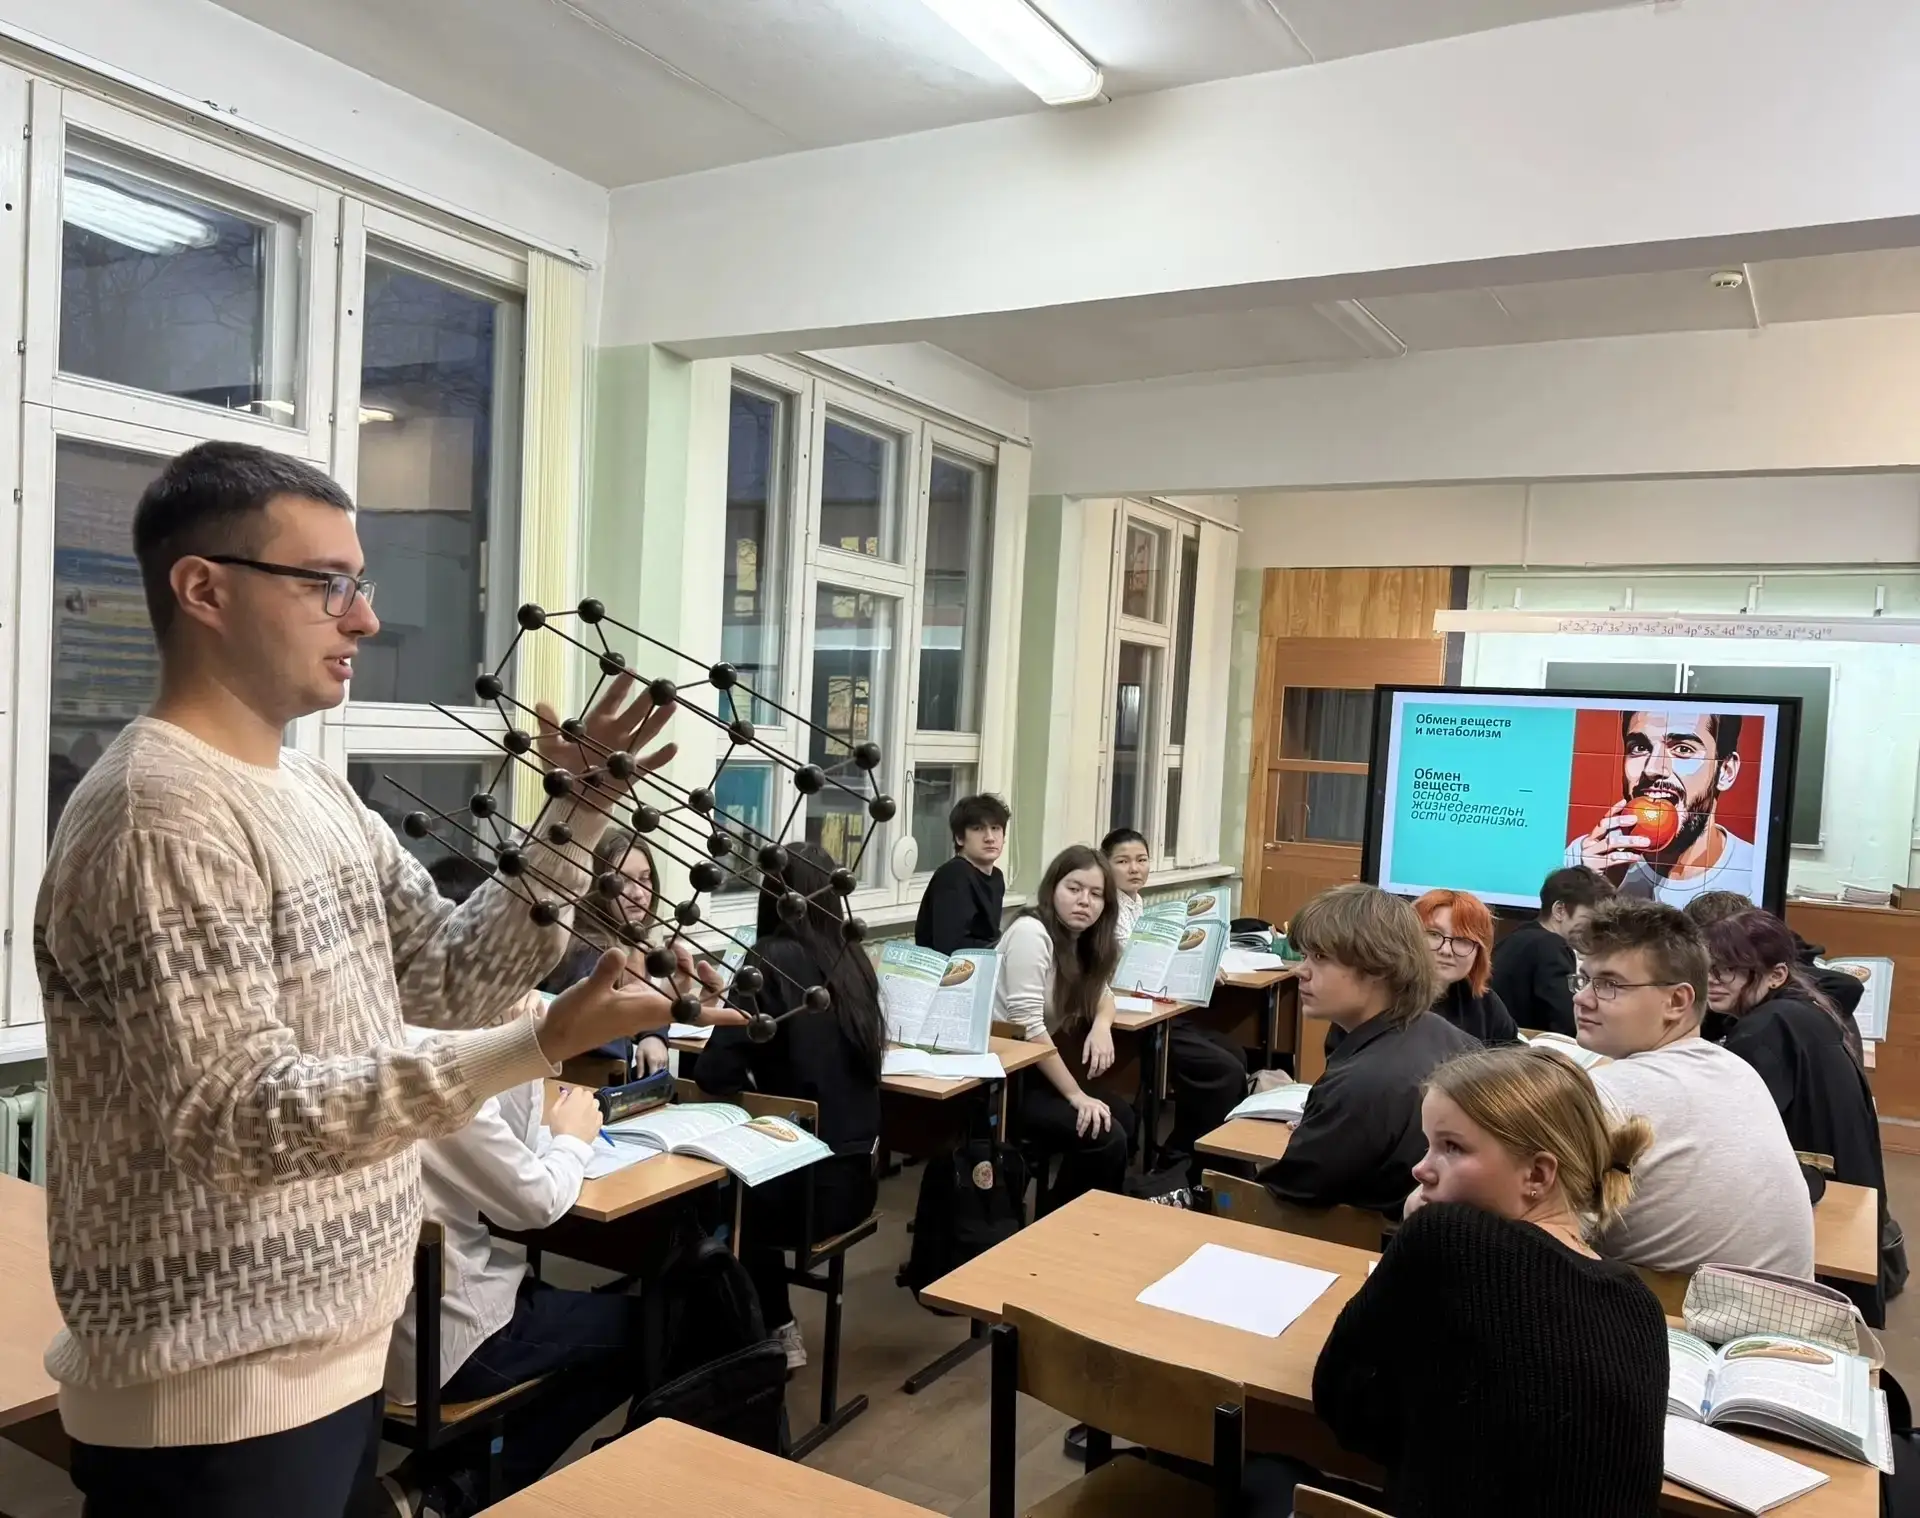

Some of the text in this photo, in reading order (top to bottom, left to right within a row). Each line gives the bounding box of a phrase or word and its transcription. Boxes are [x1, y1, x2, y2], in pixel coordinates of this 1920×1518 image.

[1416, 713, 1512, 728] Обмен веществ
[1415, 726, 1502, 738] и метаболизм
[1414, 768, 1461, 781] Обмен
[1413, 780, 1470, 793] веществ
[1412, 790, 1460, 802] основа
[1411, 798, 1525, 817] жизнедеятельн
[1410, 810, 1528, 828] ости организма.
